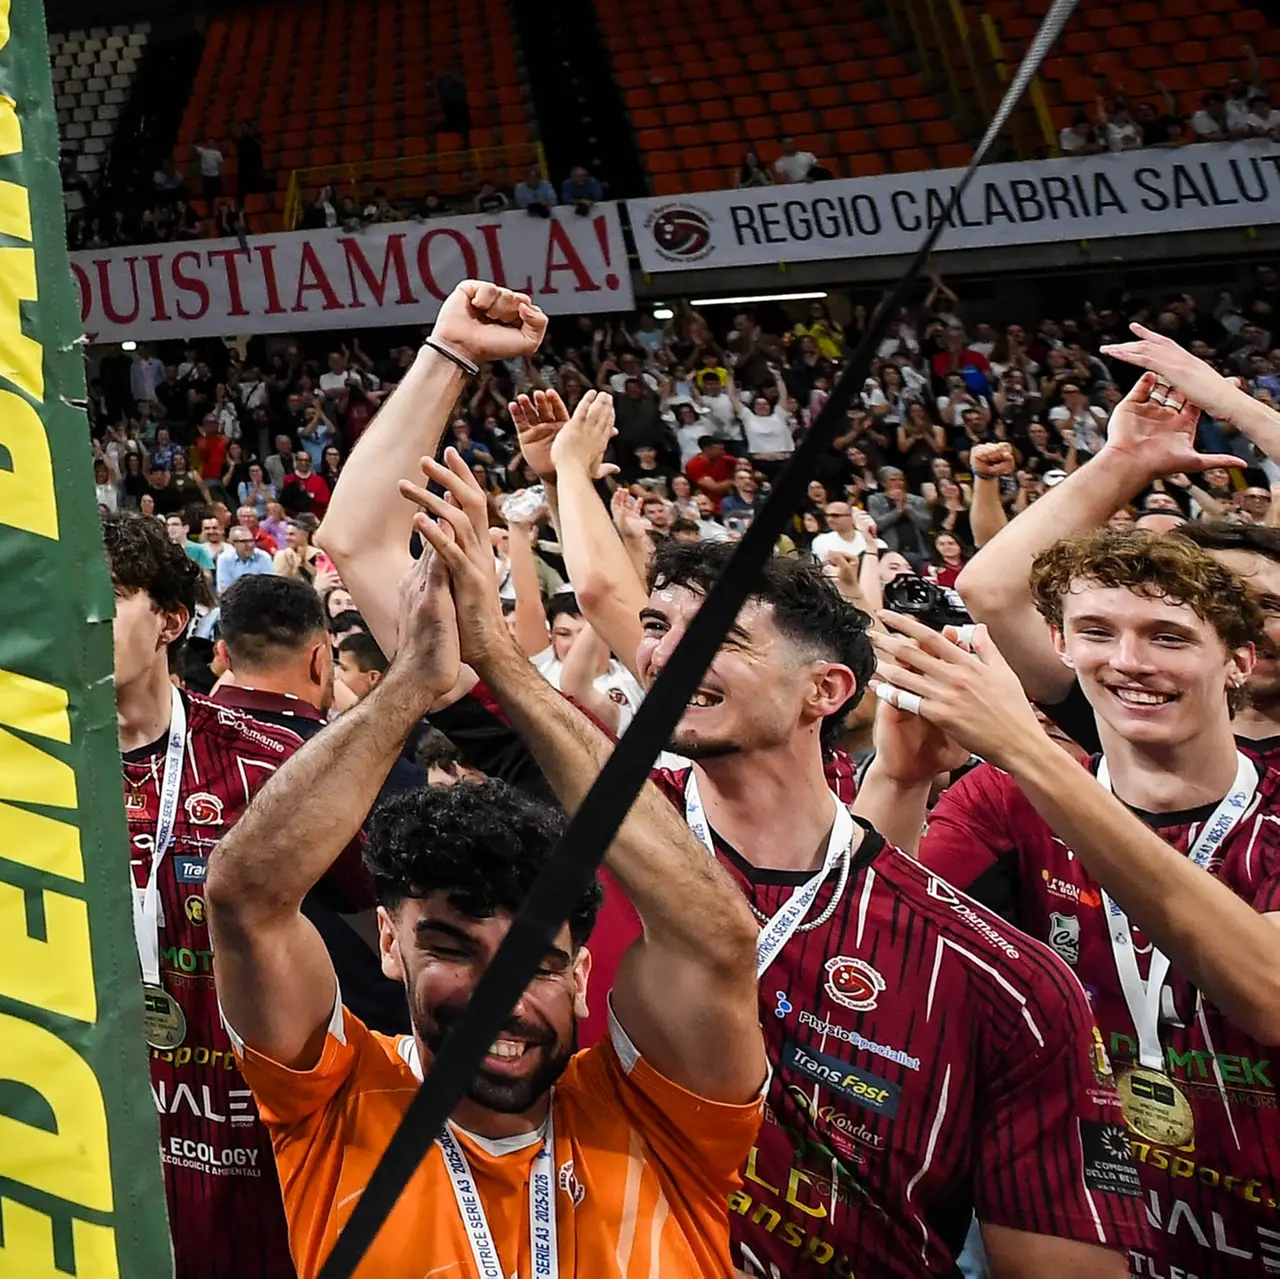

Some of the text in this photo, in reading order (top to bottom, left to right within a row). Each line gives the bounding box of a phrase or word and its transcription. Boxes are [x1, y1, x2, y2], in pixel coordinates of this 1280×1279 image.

[729, 195, 882, 247] REGGIO
[890, 171, 1126, 232] CALABRIA
[798, 1010, 921, 1072] PhysioSpecialist
[169, 1137, 260, 1167] ECOLOGY
[456, 1179, 474, 1194] A3
[462, 1195, 485, 1229] SERIE
[535, 1226, 550, 1242] A3
[536, 1242, 551, 1276] SERIE
